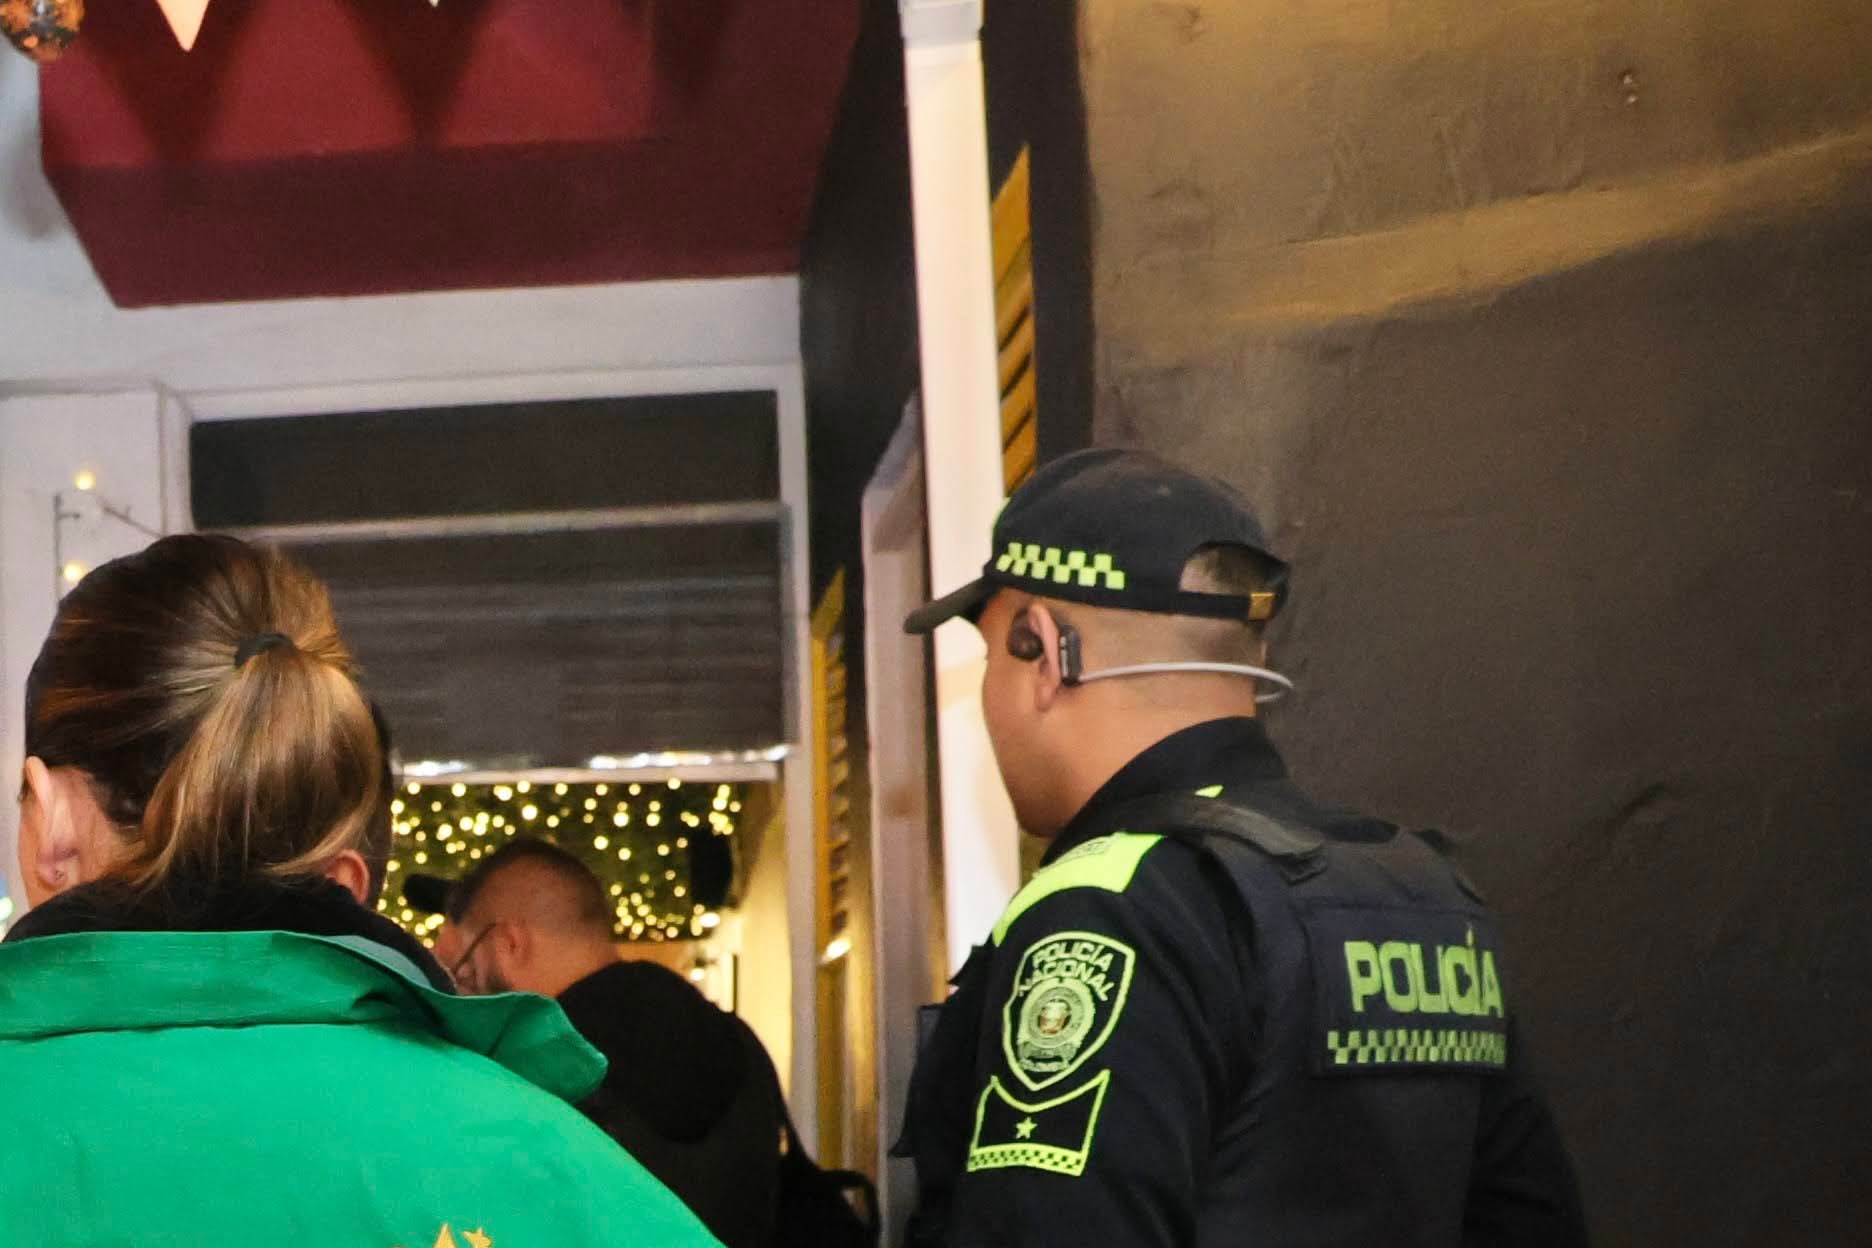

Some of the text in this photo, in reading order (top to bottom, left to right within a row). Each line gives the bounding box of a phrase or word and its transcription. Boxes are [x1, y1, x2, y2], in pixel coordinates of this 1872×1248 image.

[1031, 941, 1114, 972] POLICÍA
[1343, 922, 1504, 1028] POLICÍA
[1018, 959, 1115, 1001] NACIONAL
